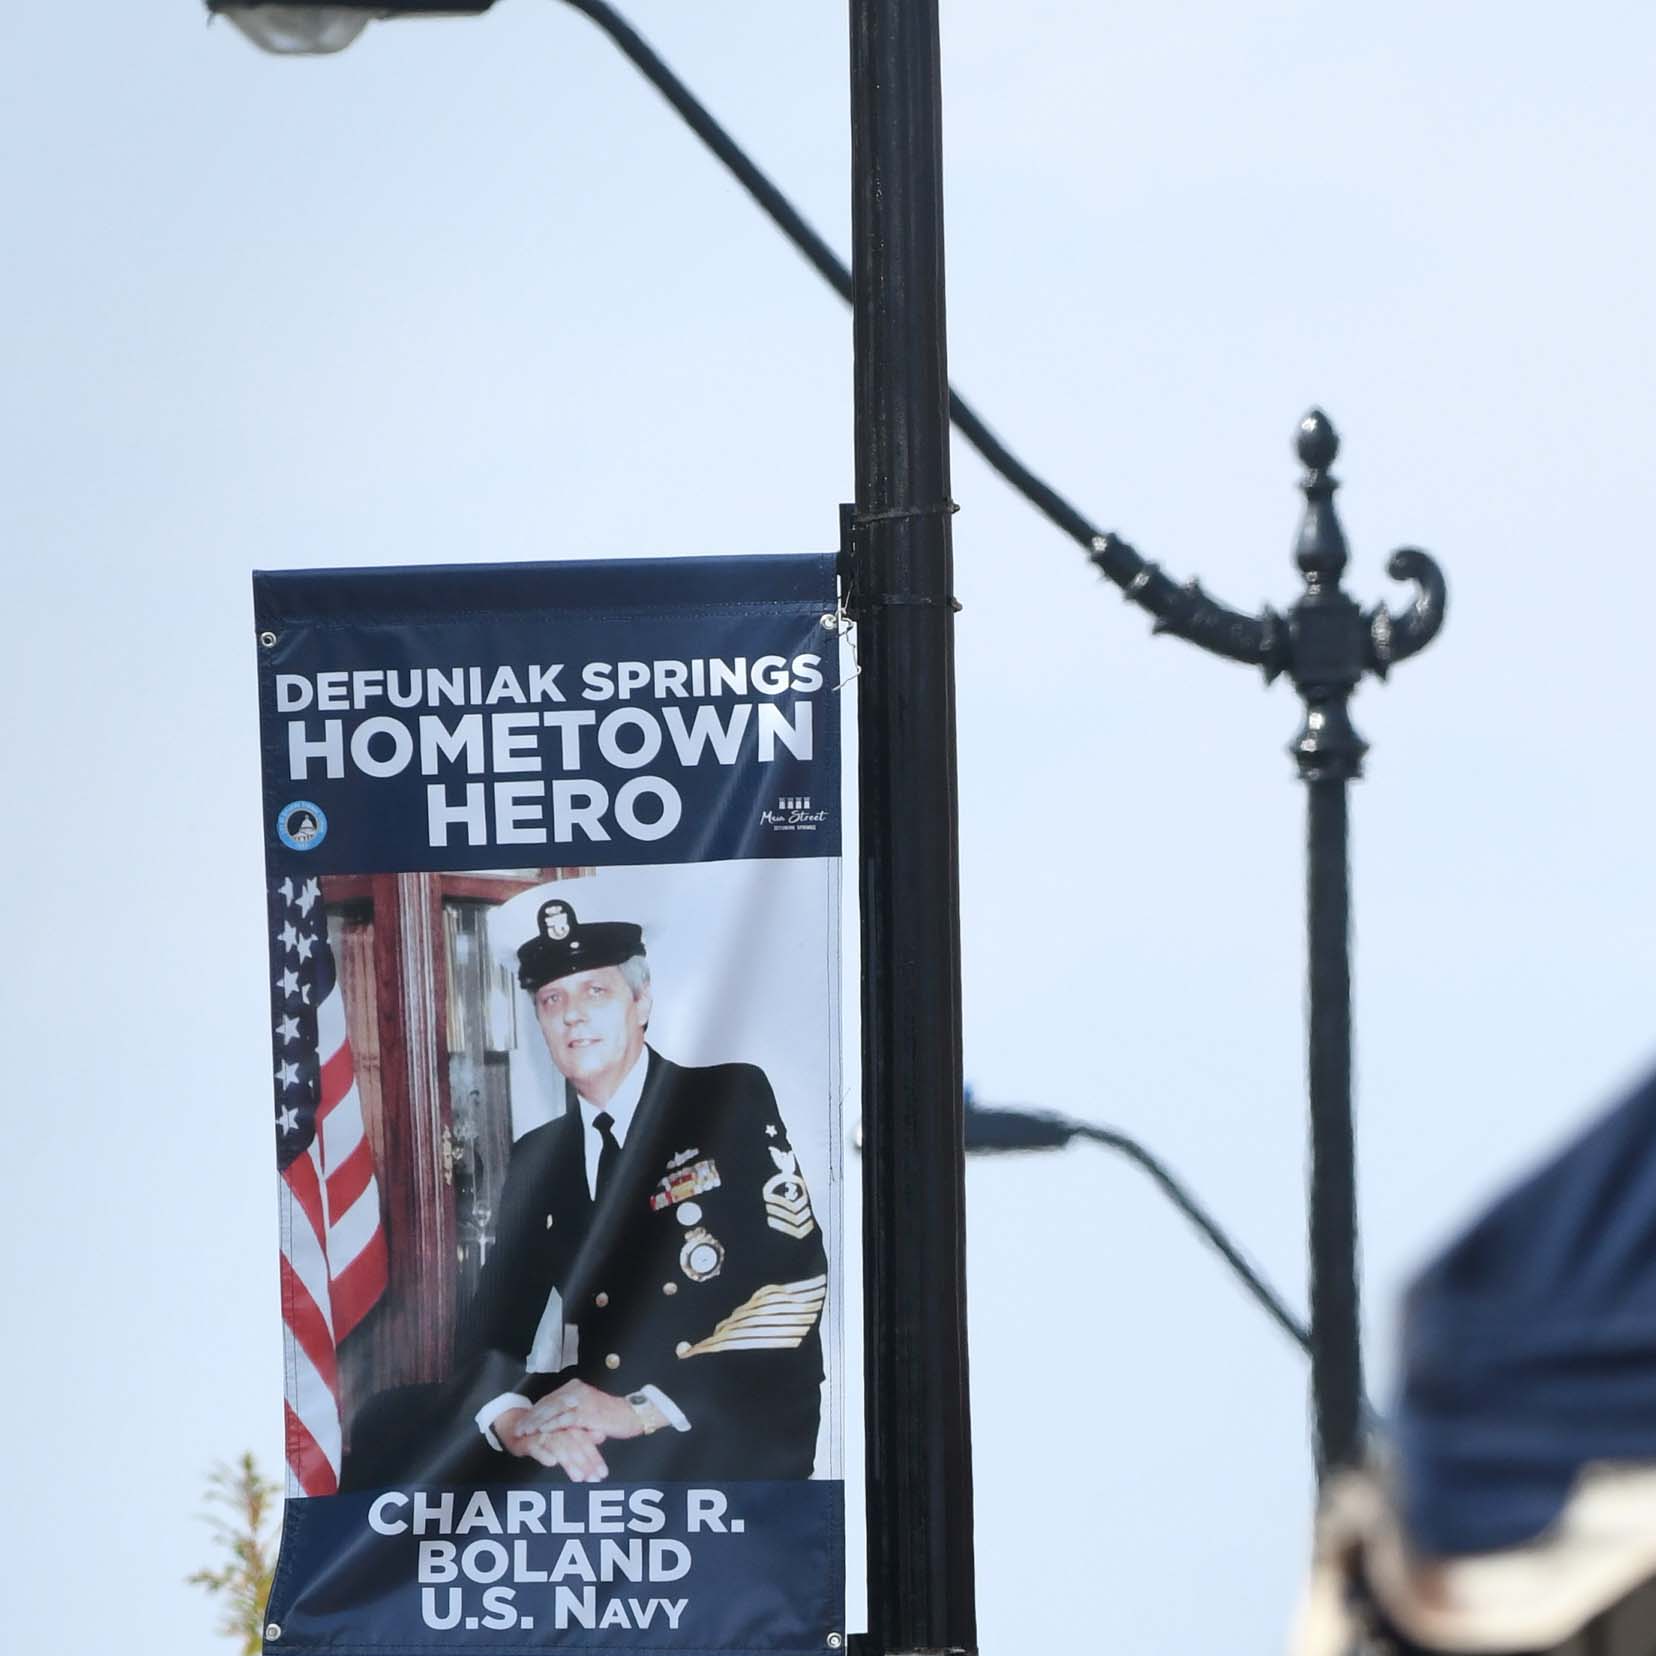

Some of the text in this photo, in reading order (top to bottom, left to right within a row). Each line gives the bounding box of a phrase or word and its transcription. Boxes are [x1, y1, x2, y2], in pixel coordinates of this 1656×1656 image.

[275, 654, 823, 713] DEFUNIAK SPRINGS
[286, 700, 815, 780] HOMETOWN
[426, 775, 683, 847] HERO
[788, 809, 830, 824] Street
[367, 1488, 745, 1536] CHARLES R.
[417, 1538, 693, 1584] BOLAND
[420, 1586, 535, 1631] U.S.
